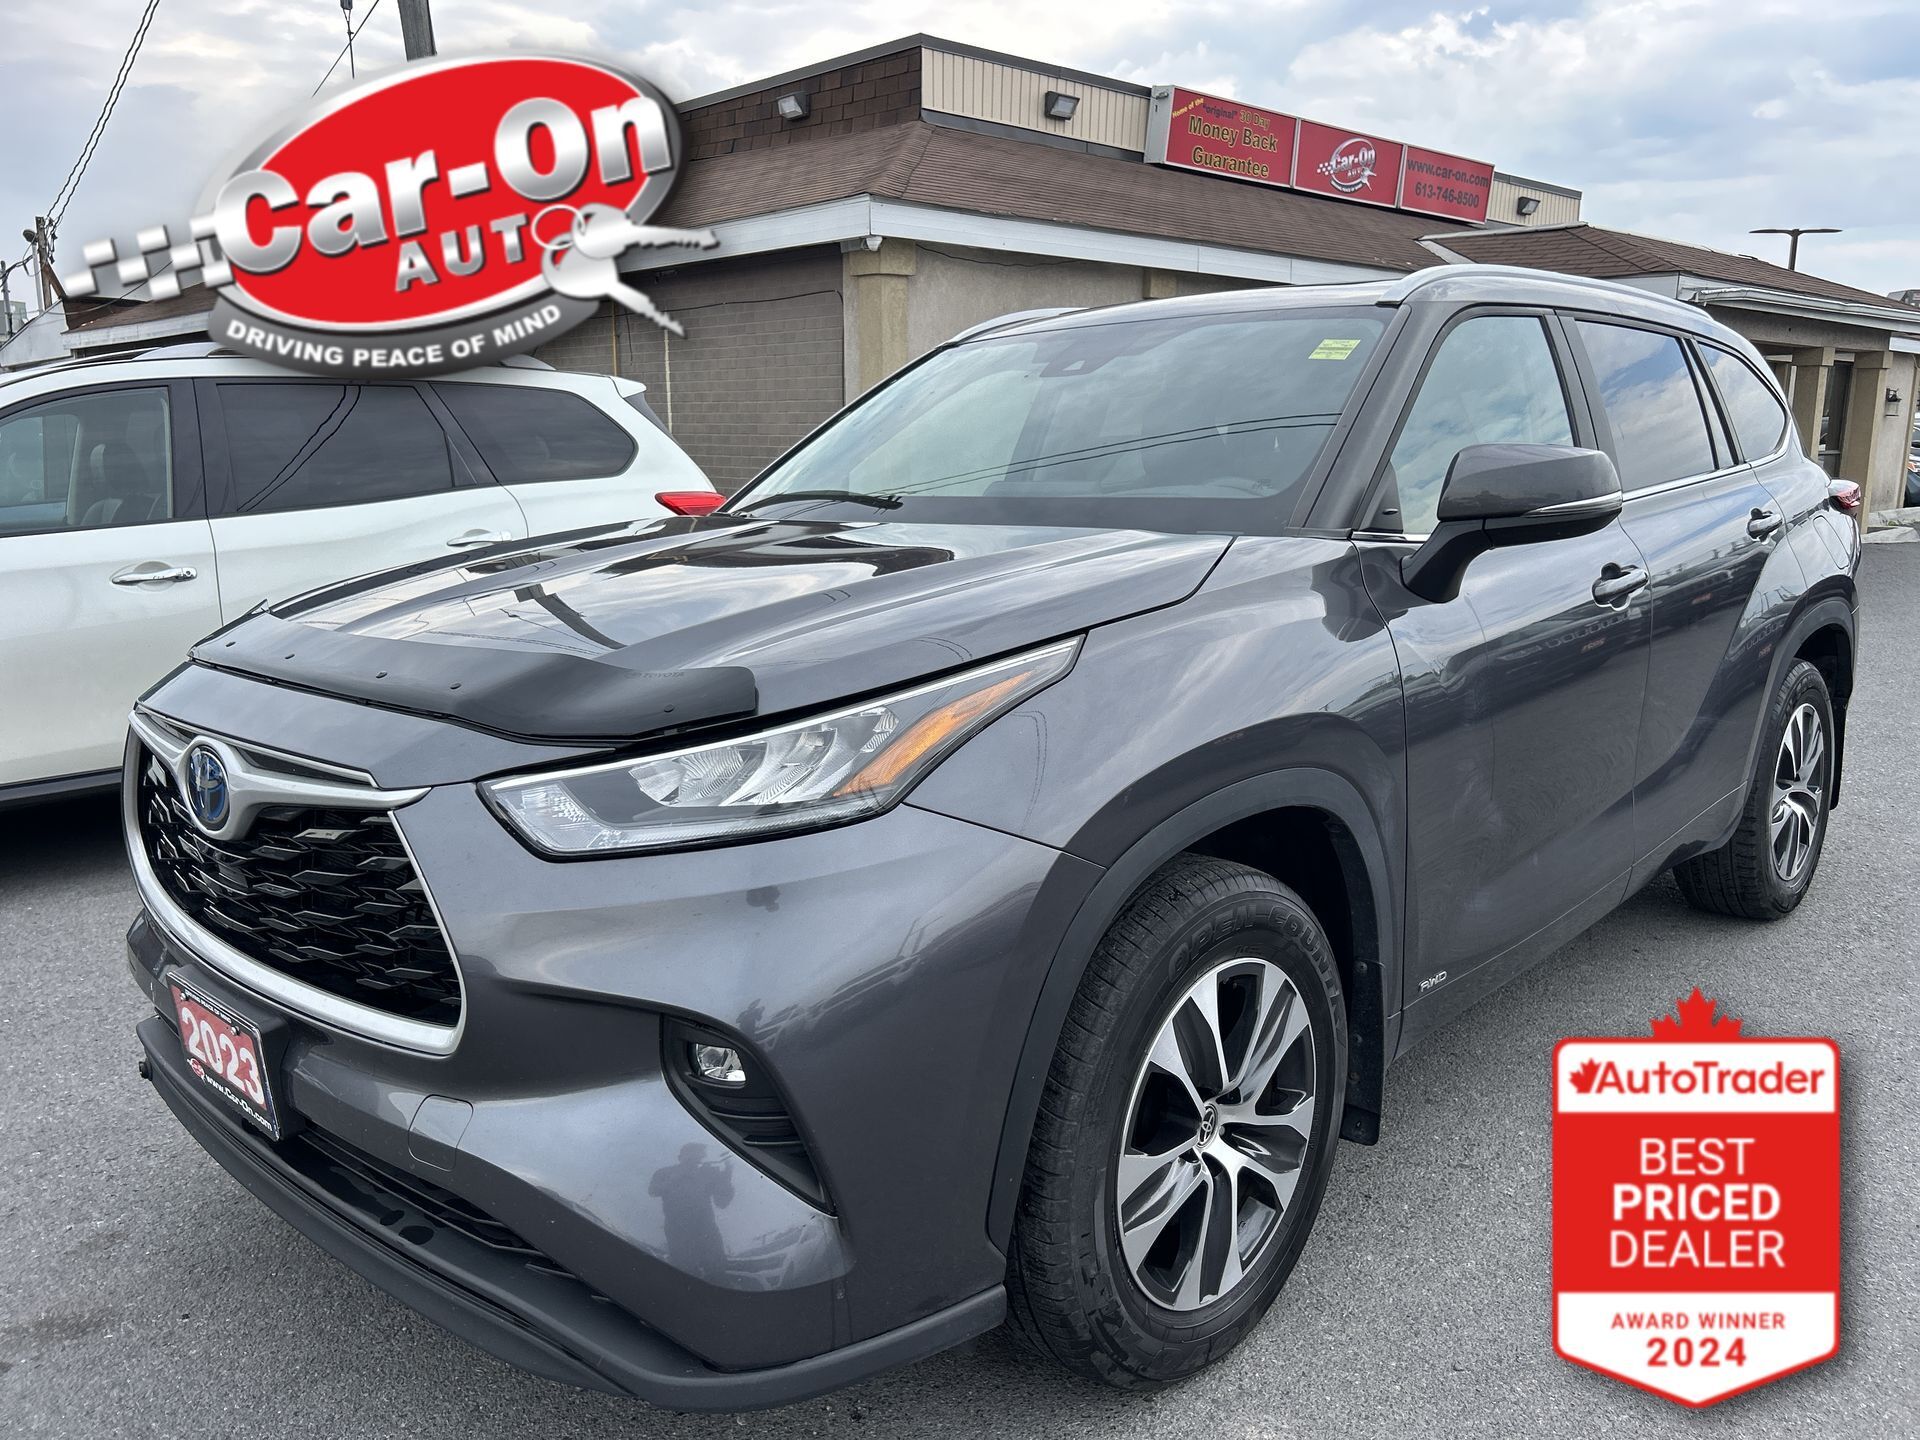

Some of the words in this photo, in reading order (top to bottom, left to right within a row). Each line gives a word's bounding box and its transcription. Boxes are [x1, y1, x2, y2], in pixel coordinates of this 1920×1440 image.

[1172, 106, 1188, 119] Home
[1252, 112, 1271, 130] Day
[1188, 114, 1239, 148] Money
[1242, 127, 1278, 152] Back
[1192, 145, 1270, 178] Guarantee
[1331, 147, 1376, 173] Car-On
[1407, 160, 1489, 188] www.car-on.com
[1415, 182, 1480, 208] 613-746-8500
[1420, 971, 1448, 992] AWD
[181, 1007, 265, 1105] 2023
[205, 1074, 273, 1131] www.Car-On.com
